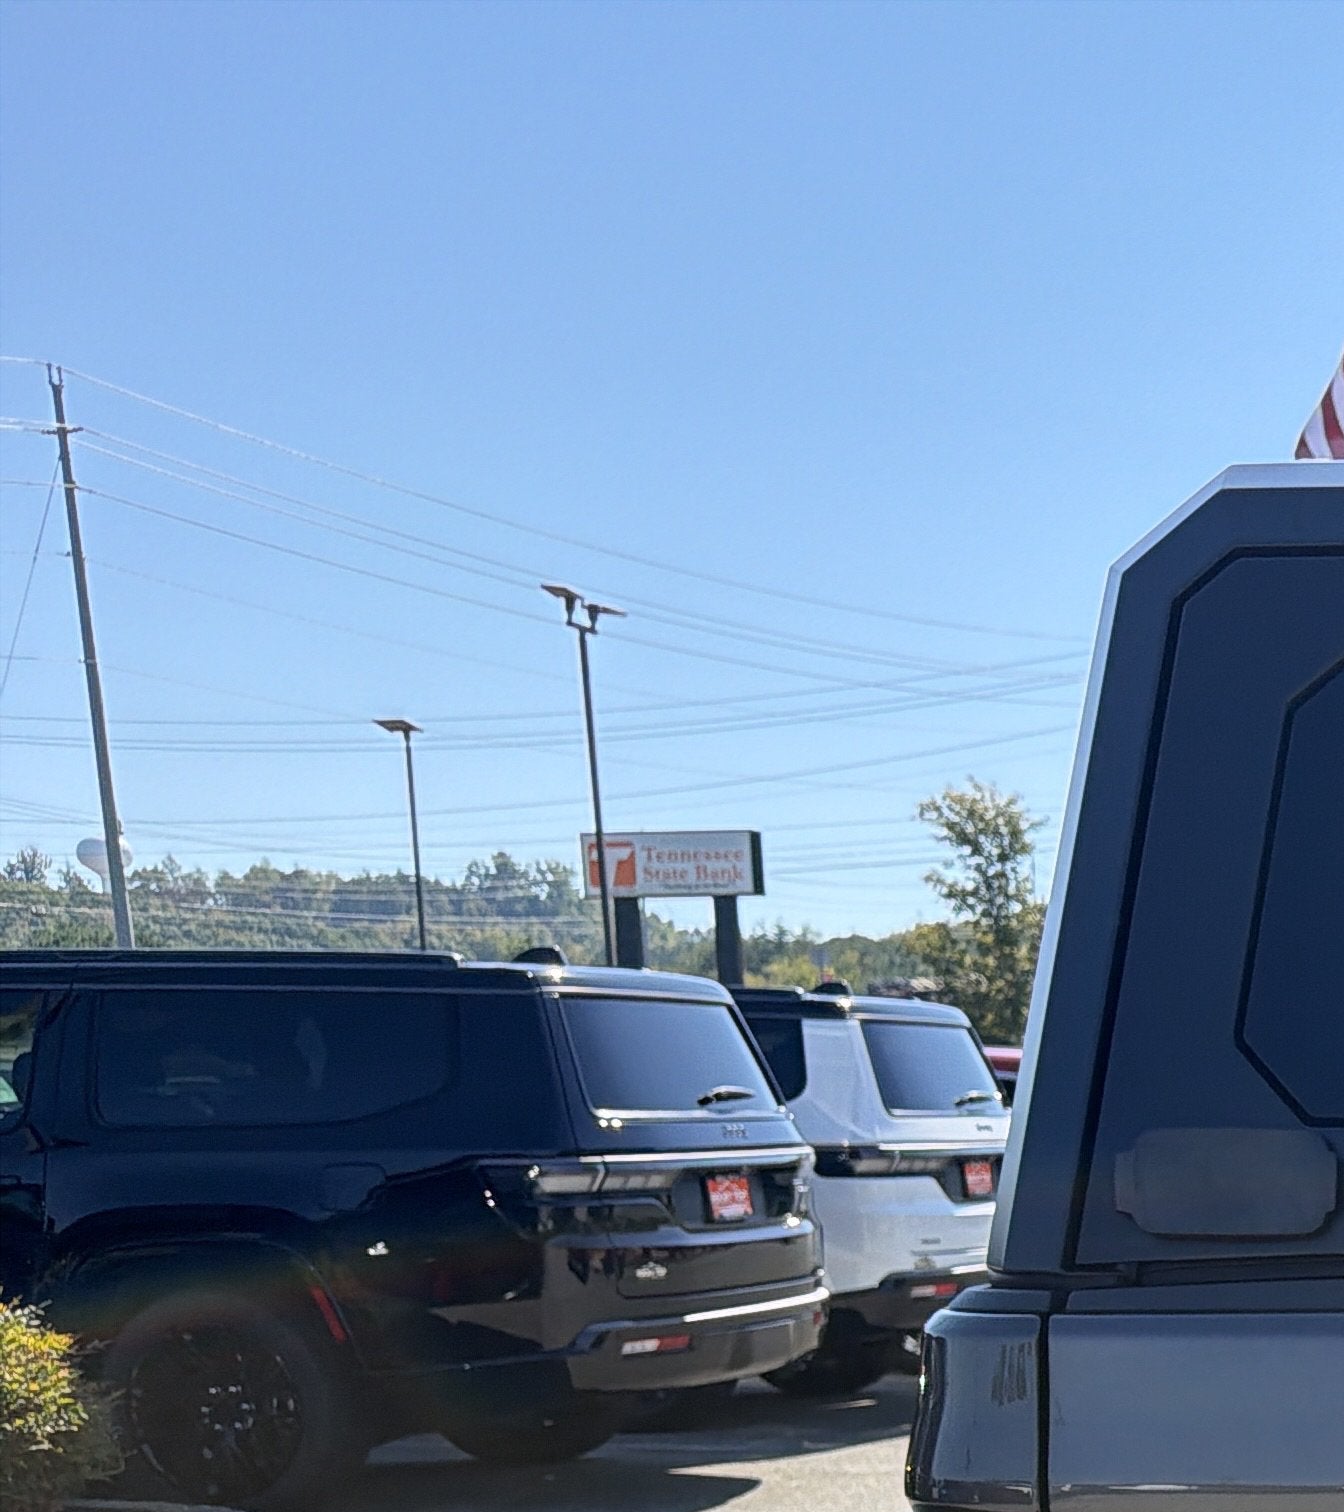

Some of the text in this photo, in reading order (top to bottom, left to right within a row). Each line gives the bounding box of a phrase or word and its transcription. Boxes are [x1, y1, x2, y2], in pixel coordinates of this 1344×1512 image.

[642, 846, 744, 863] Tennessee
[643, 865, 744, 881] State Bank
